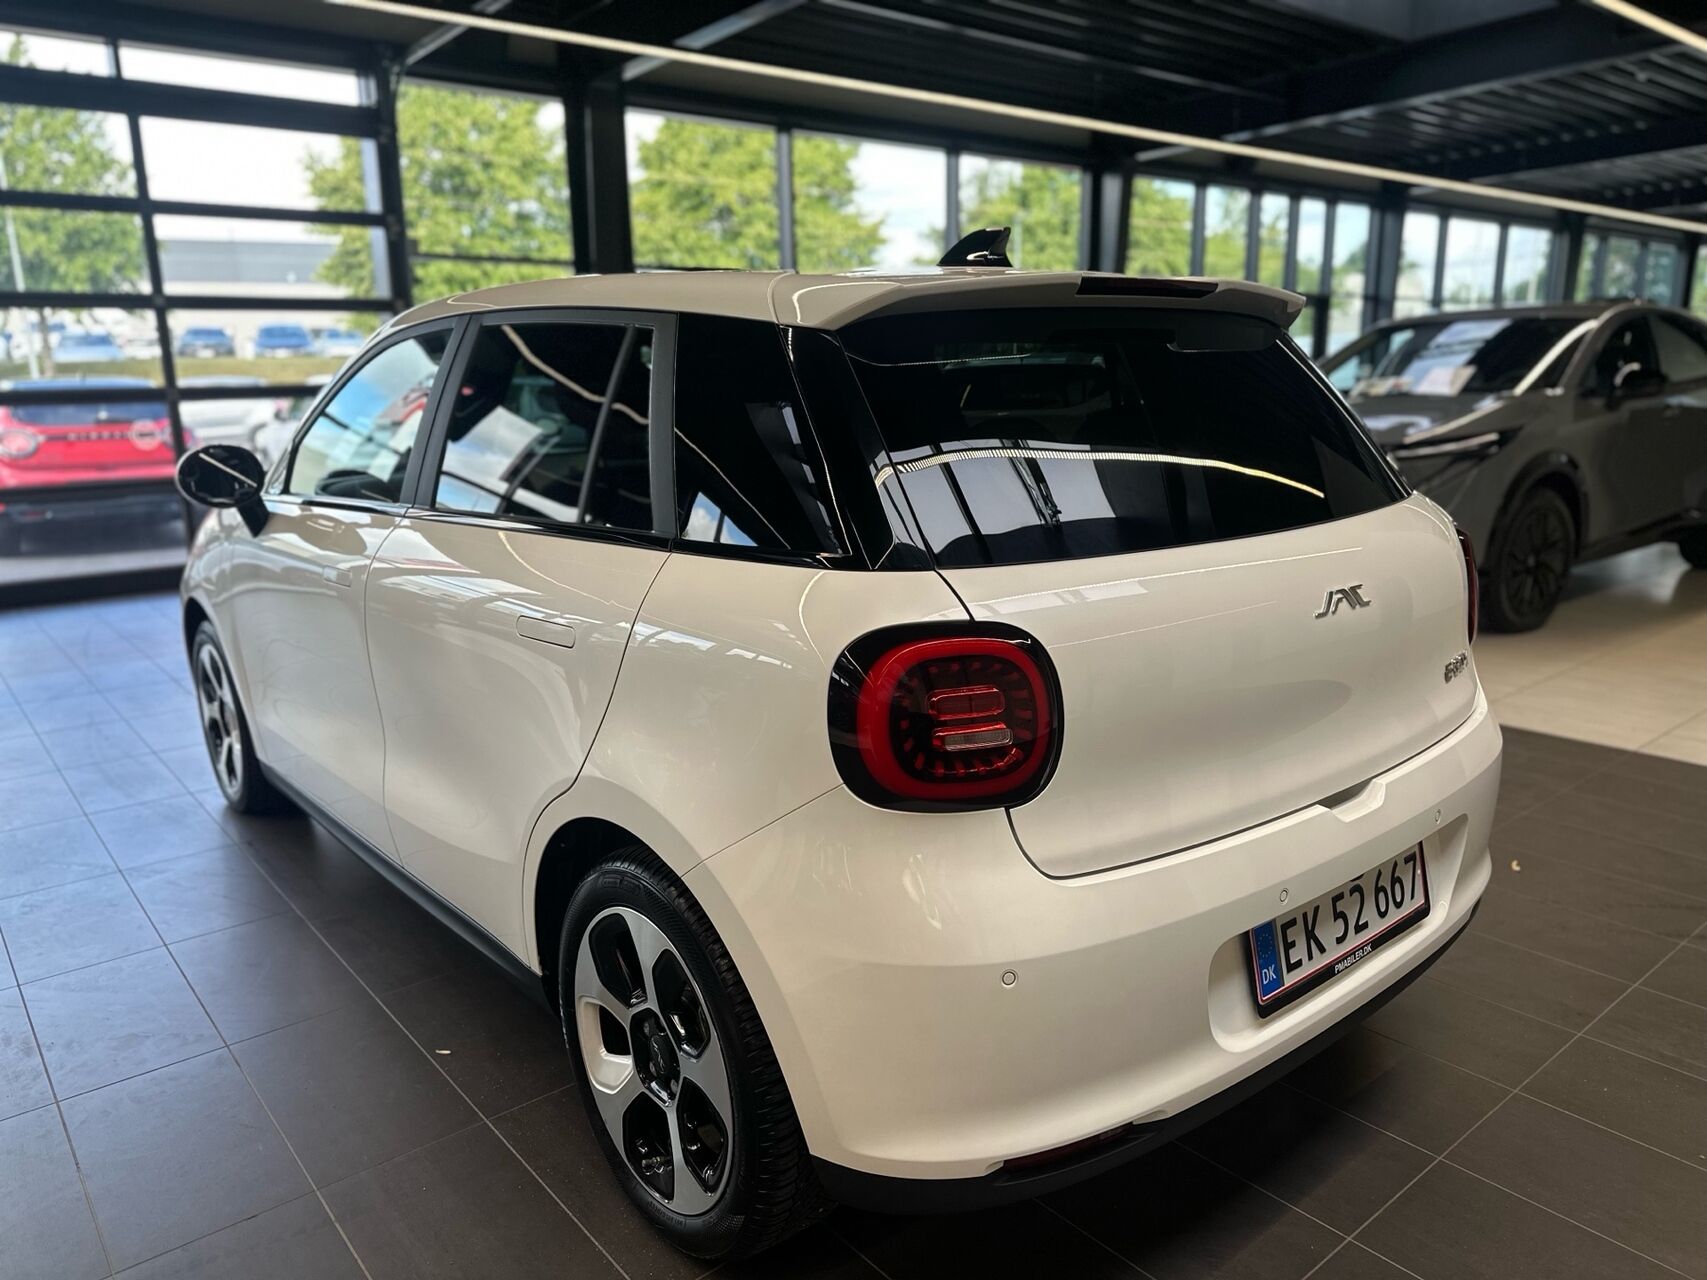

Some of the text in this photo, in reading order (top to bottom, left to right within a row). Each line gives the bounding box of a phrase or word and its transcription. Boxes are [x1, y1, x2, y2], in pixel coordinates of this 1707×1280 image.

[1312, 583, 1372, 619] JAC
[1280, 851, 1417, 974] EK 52 667
[1262, 963, 1277, 985] DK
